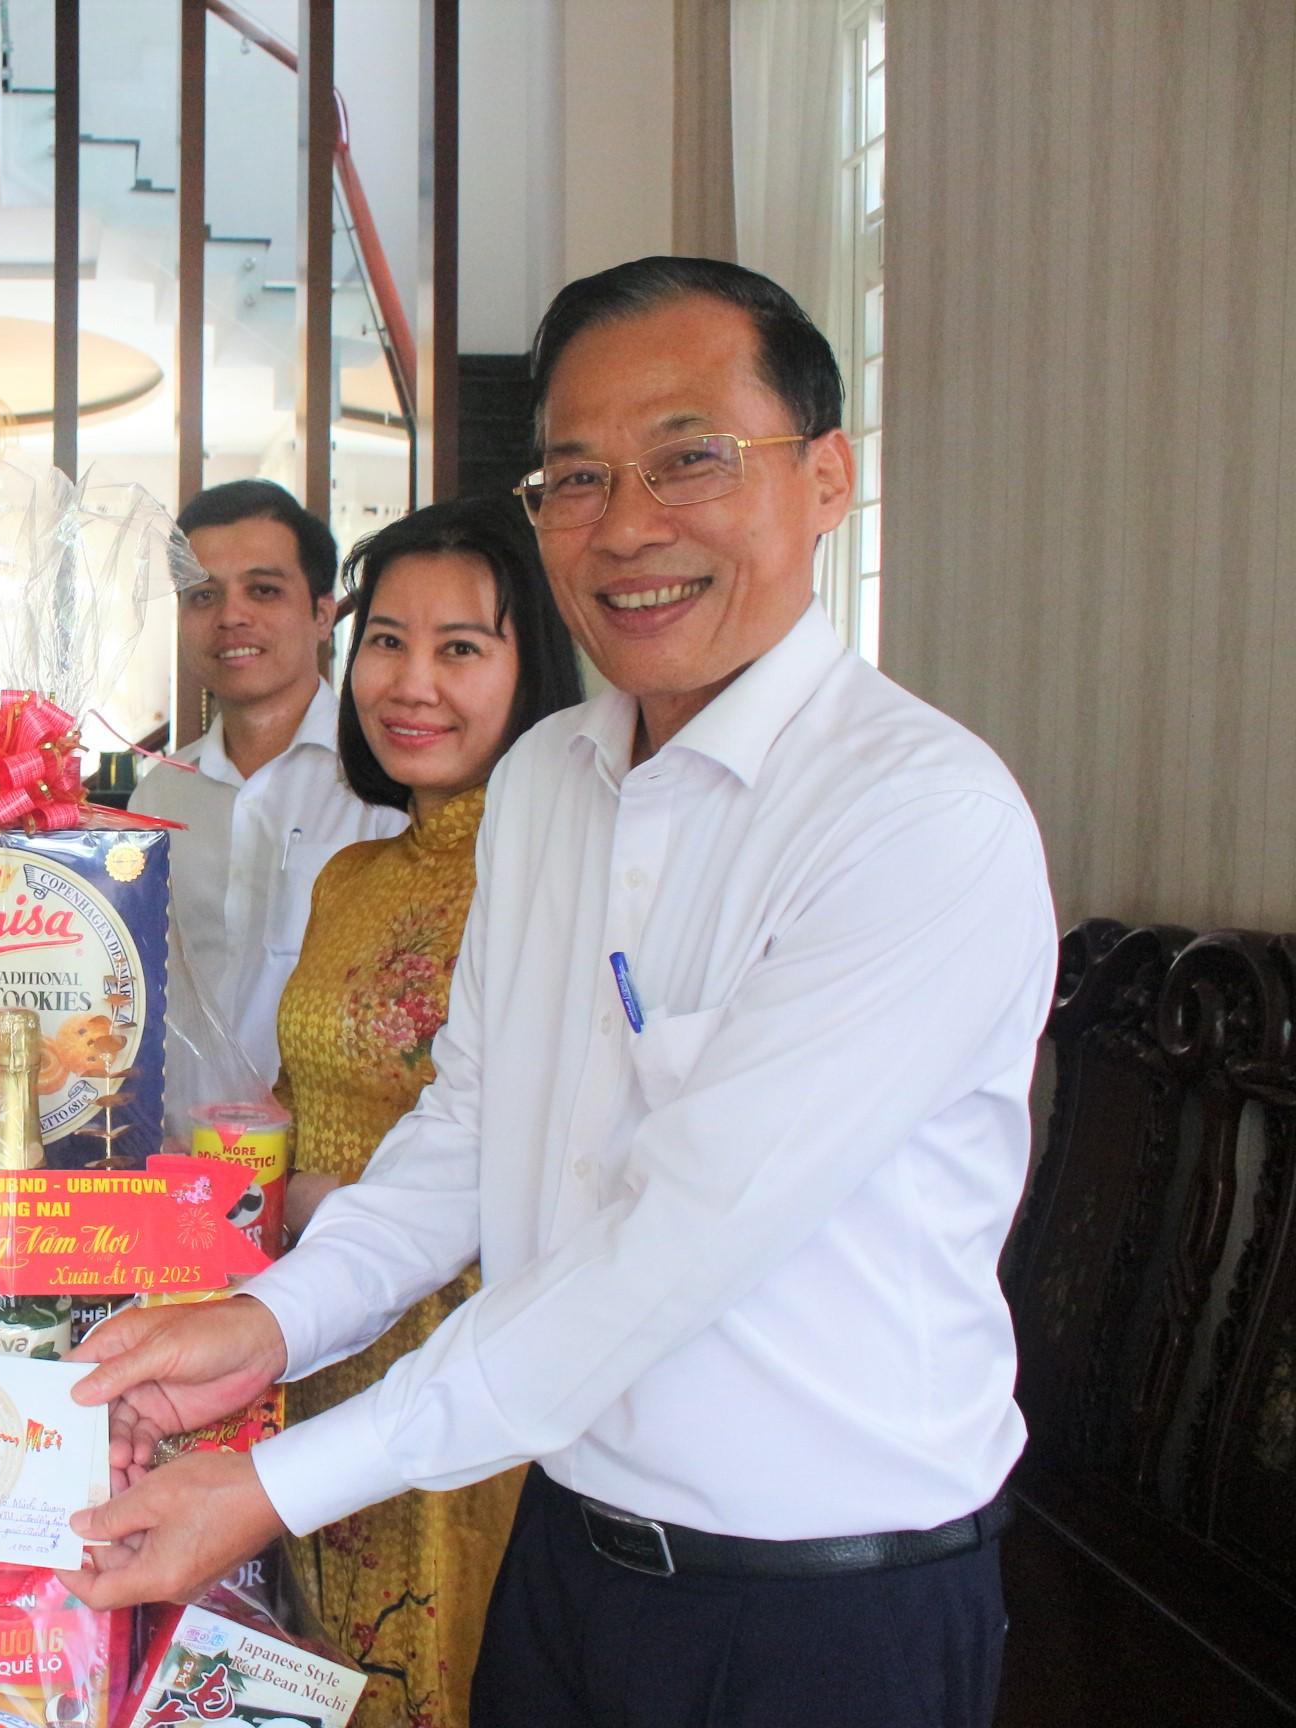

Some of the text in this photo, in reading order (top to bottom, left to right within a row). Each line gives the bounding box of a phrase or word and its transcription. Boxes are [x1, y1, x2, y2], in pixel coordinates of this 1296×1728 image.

[40, 873, 115, 941] COPENHAGEN
[40, 1109, 68, 1131] ETTO
[68, 1098, 84, 1114] 681
[223, 1145, 256, 1156] MORE
[67, 1177, 167, 1194] UBMTTQVN
[37, 1201, 71, 1217] NAI
[49, 1260, 201, 1289] Xuân Ất Tỵ 2025
[237, 1636, 303, 1673] Japanese
[304, 1663, 340, 1688] Style
[229, 1655, 349, 1713] Red Bean Mochi
